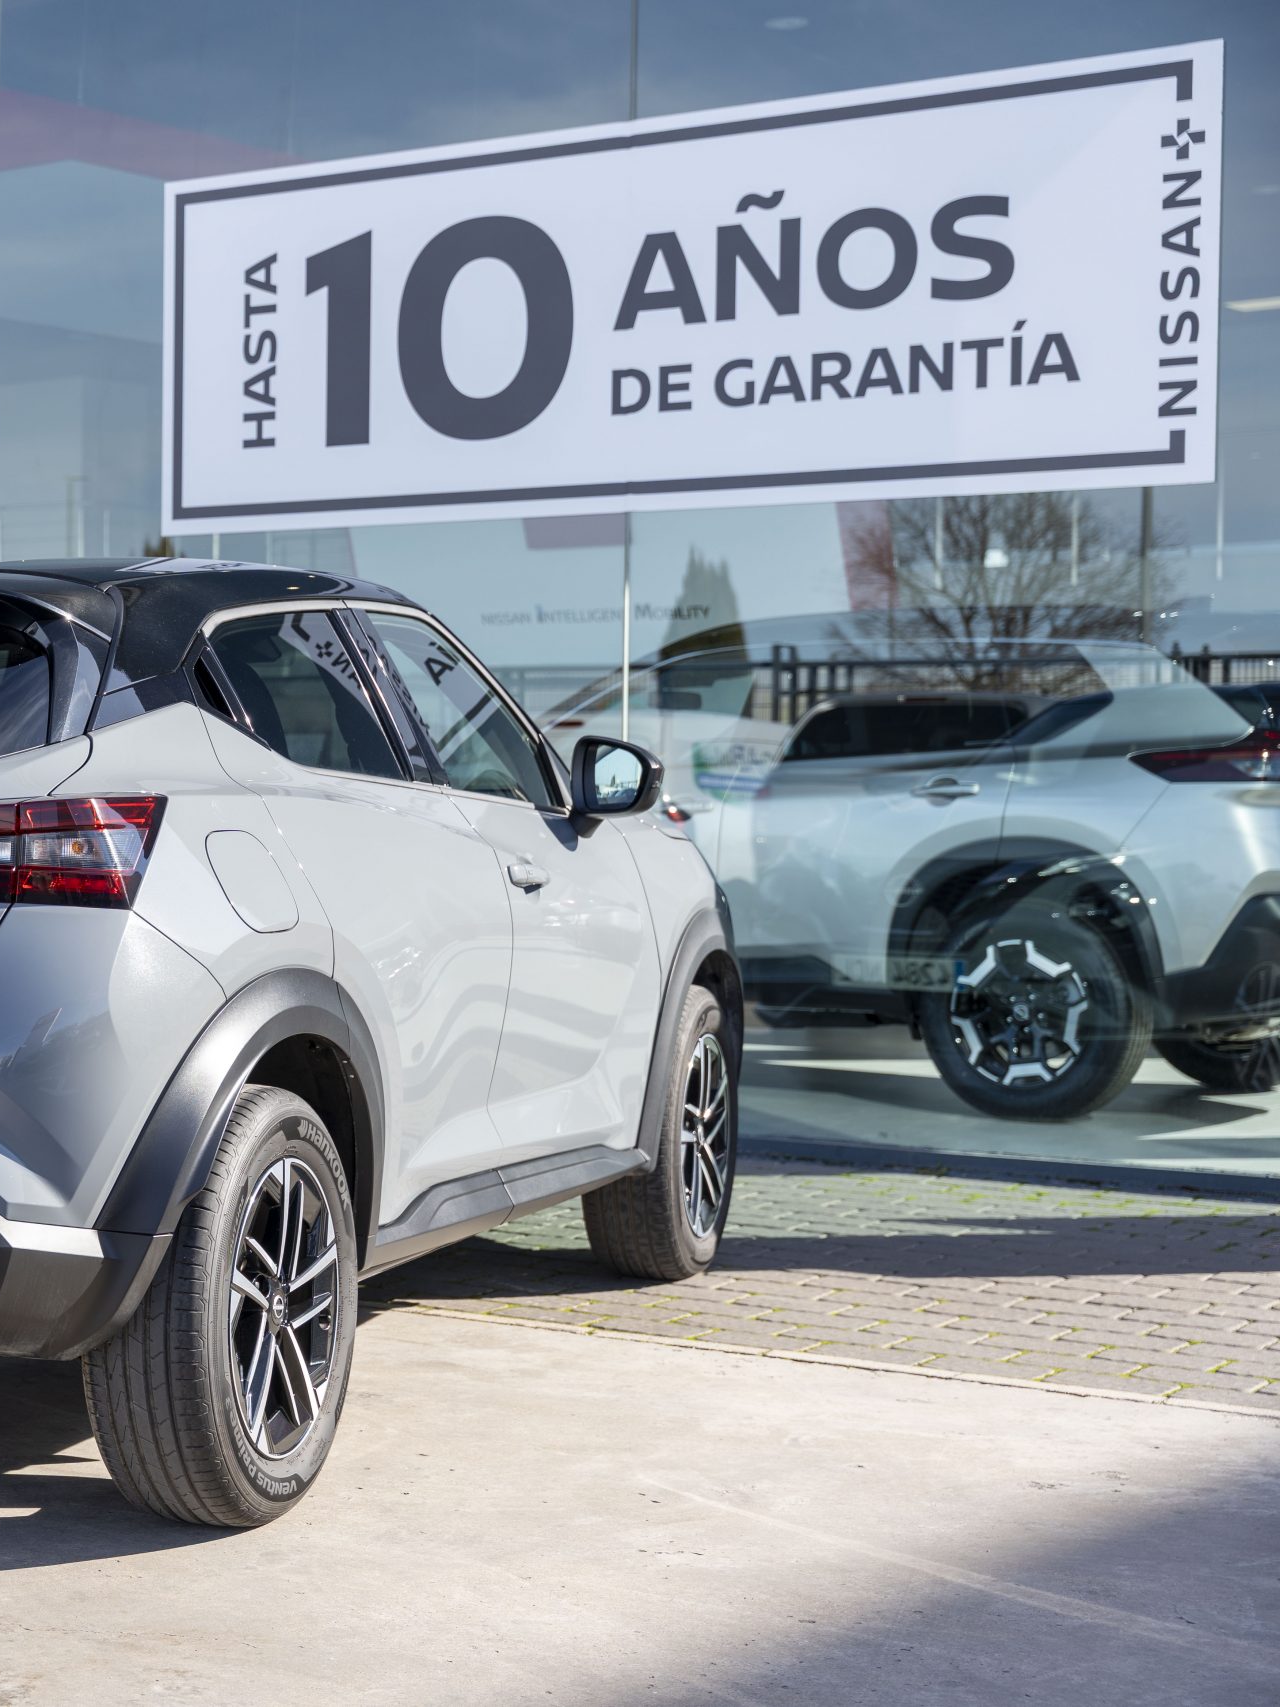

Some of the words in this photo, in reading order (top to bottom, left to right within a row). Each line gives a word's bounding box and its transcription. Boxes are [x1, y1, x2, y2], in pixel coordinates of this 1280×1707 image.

[305, 214, 574, 448] 10
[613, 189, 1016, 331] AÑOS
[242, 253, 277, 448] HASTA
[610, 363, 693, 416] DE
[713, 319, 1081, 408] GARANTÍA
